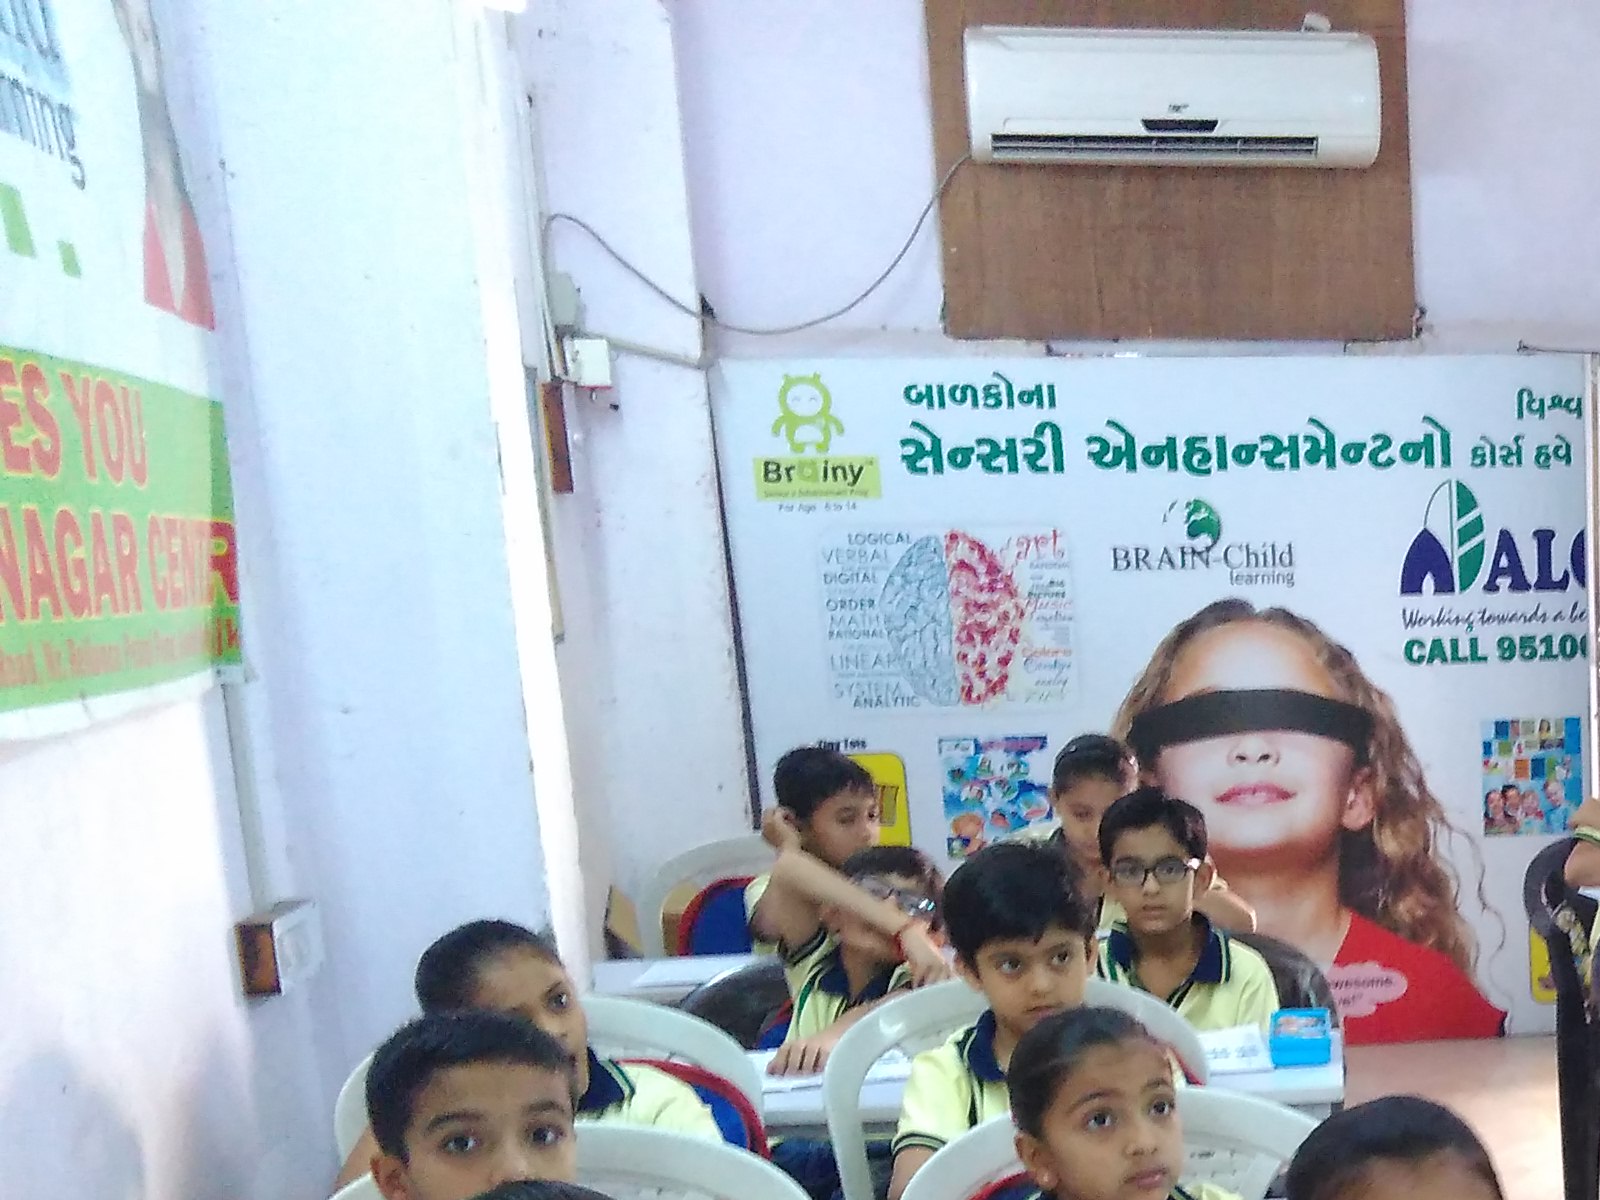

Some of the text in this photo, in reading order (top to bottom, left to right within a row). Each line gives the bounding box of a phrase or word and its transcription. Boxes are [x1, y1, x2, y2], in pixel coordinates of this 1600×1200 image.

[903, 371, 1056, 410] બાળકોના
[60, 372, 148, 488] YOU
[900, 416, 1572, 476] સેન્સરી એનહાન્સમેન્ટનો કોર્સ હવે
[847, 532, 912, 545] LOGICAL
[822, 546, 889, 564] VERBAL
[823, 571, 878, 585] DIGITAL
[1229, 569, 1296, 588] learning
[825, 598, 876, 612] ORDER
[1402, 607, 1475, 632] Working
[1476, 602, 1548, 625] towards
[1553, 612, 1568, 625] a
[1403, 635, 1488, 664] CALL
